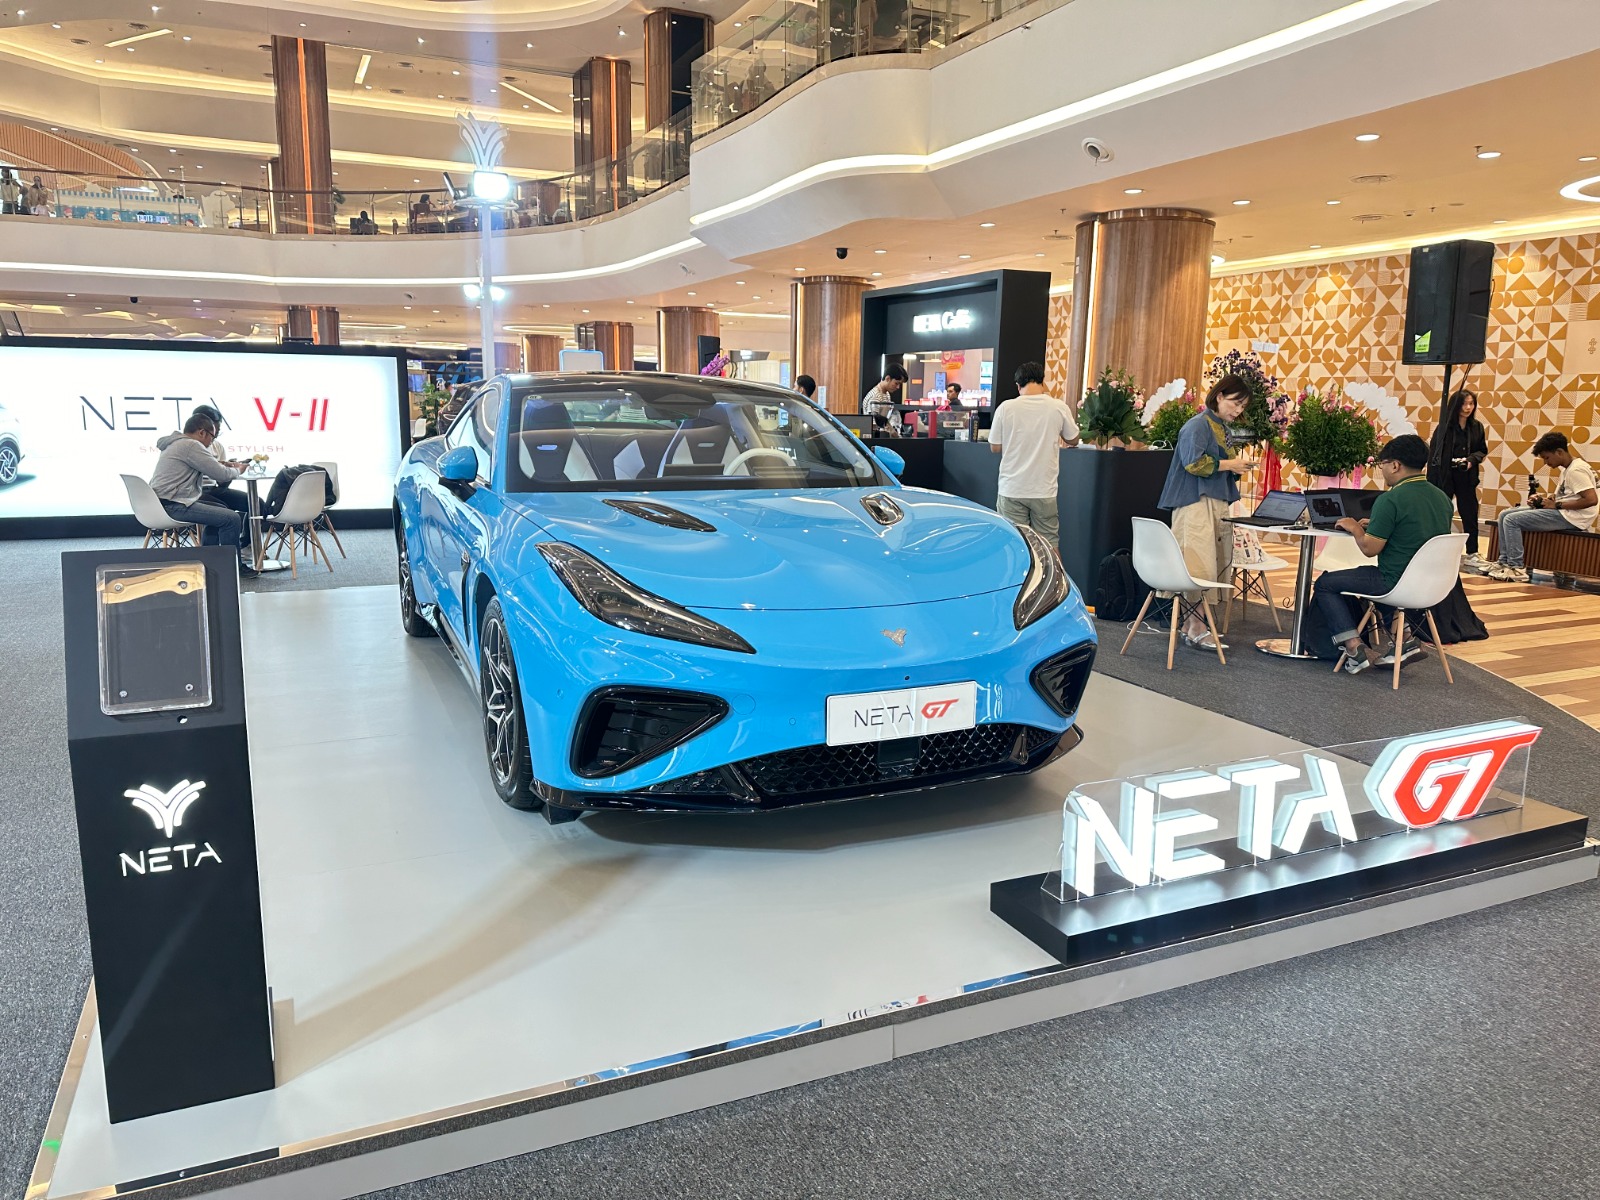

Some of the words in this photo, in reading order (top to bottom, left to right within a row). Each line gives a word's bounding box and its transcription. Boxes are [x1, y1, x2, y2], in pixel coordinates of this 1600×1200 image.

[254, 397, 329, 431] V-II
[228, 445, 284, 453] STYLISH
[854, 705, 914, 728] NETA
[921, 698, 959, 719] GT
[1061, 754, 1357, 896] NETA
[1375, 721, 1543, 828] GT
[119, 842, 222, 877] NETA
